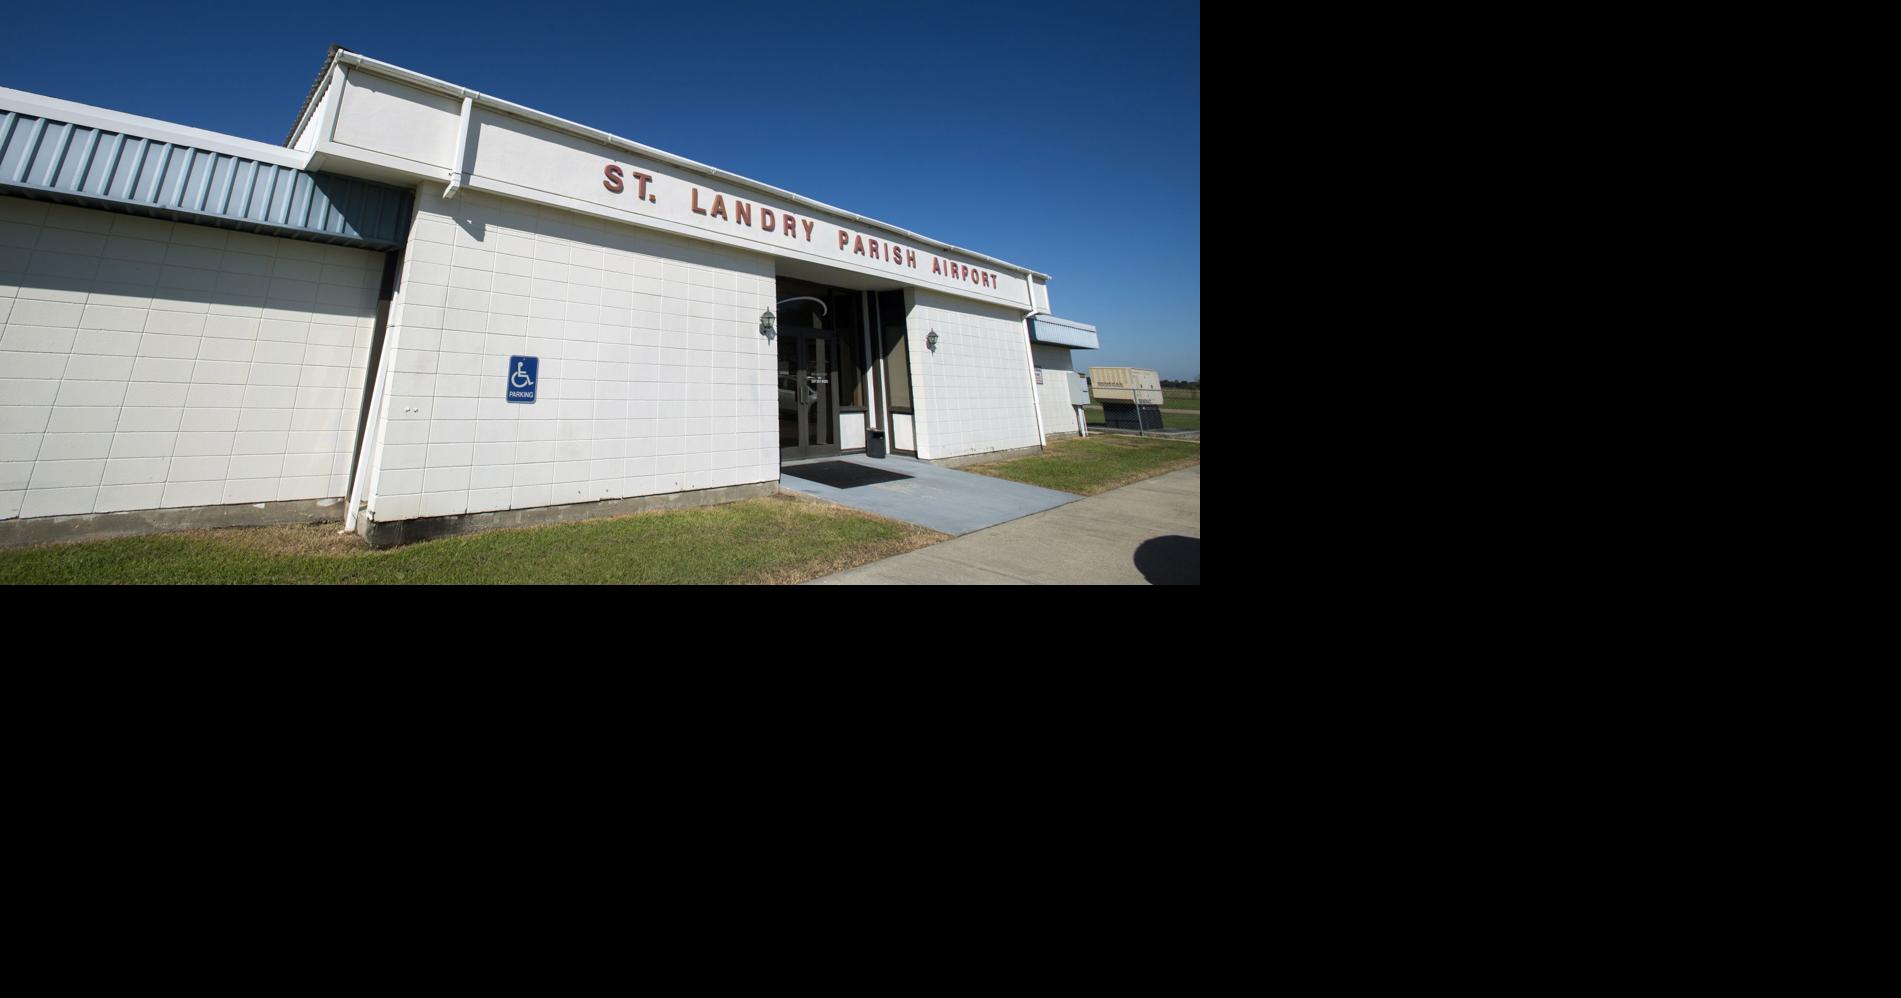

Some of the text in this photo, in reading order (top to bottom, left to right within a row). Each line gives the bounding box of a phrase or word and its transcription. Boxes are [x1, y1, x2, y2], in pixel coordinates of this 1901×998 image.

[603, 164, 998, 290] ST. LANDRY PARISH AIRPORT
